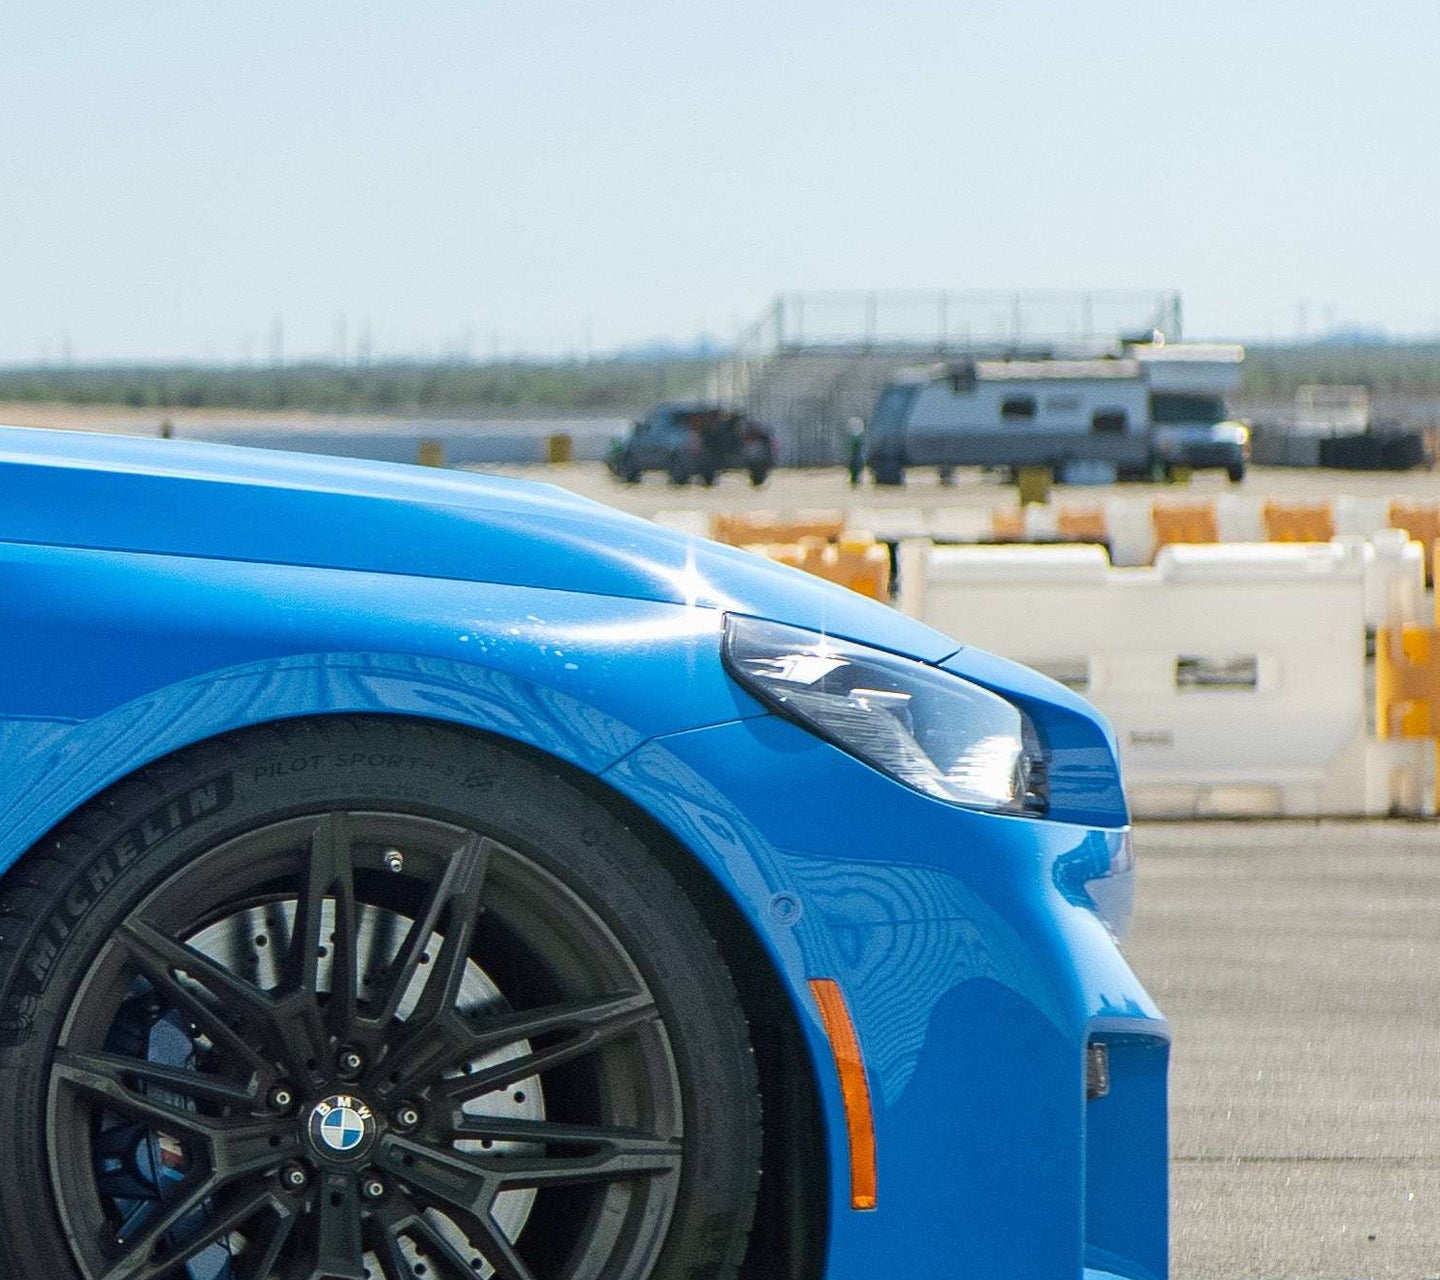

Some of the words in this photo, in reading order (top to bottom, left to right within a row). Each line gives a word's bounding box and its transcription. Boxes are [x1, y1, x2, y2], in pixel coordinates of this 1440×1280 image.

[254, 754, 324, 781] PILOT
[336, 753, 423, 770] SPORT
[25, 782, 218, 982] MICHELIN
[315, 1096, 372, 1119] BMW
